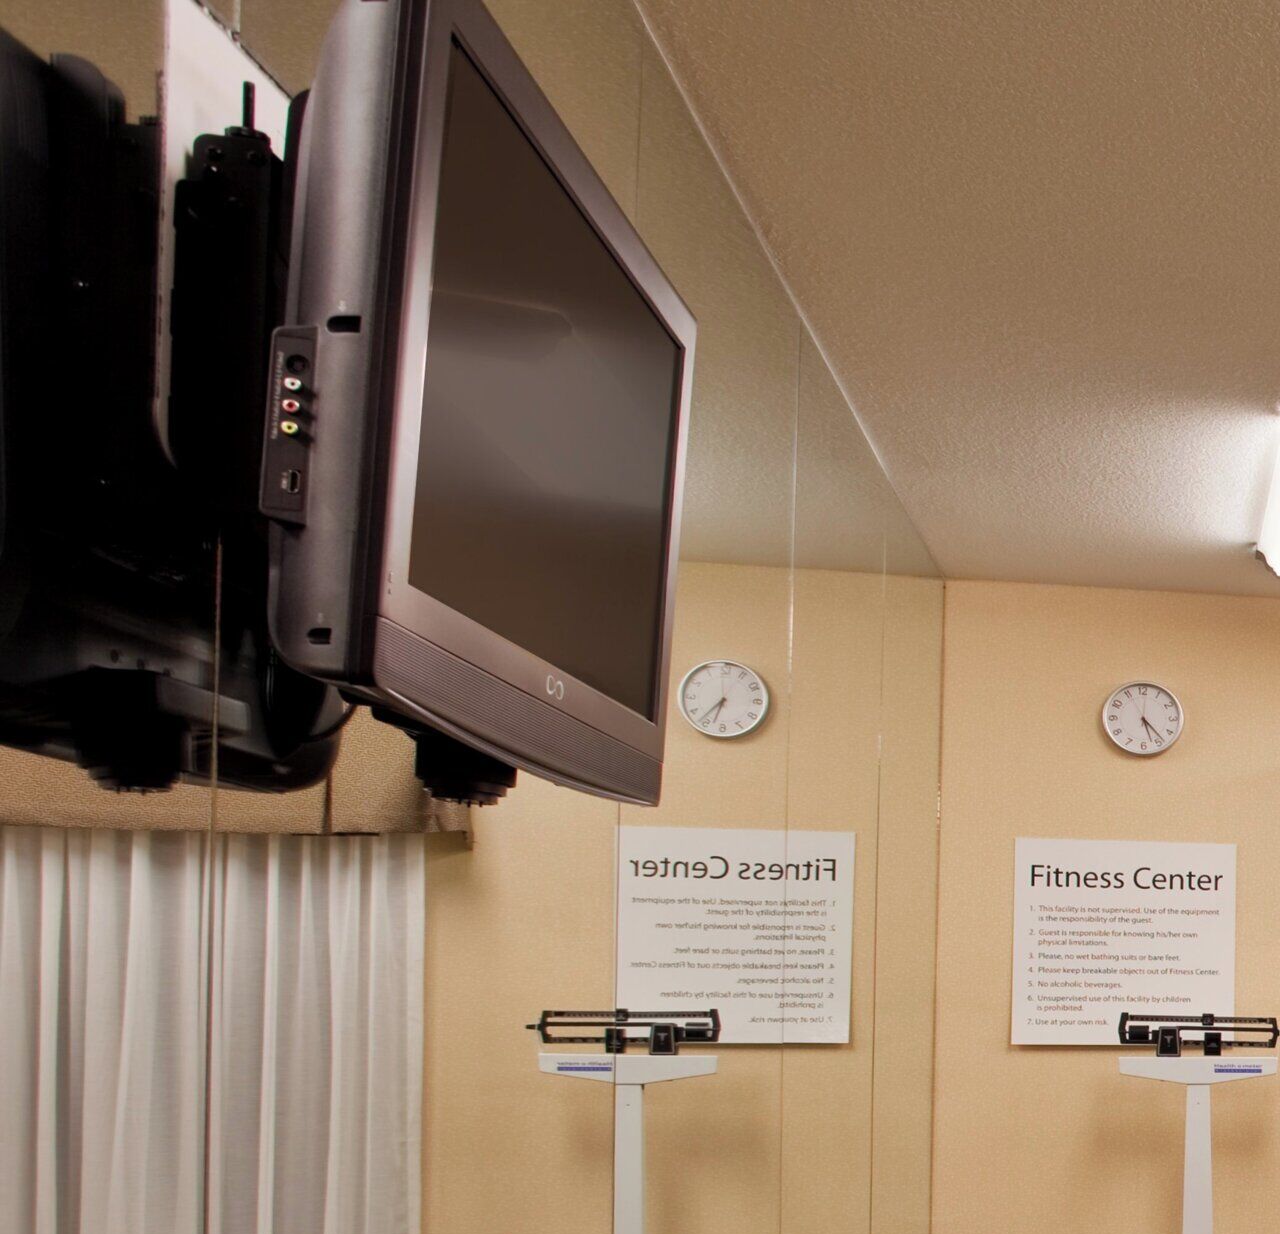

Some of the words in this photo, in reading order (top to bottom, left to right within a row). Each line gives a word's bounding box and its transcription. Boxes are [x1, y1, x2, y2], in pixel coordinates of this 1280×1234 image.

[1124, 690, 1132, 698] 11
[1138, 687, 1147, 696] 12
[1155, 691, 1160, 699] 1
[1112, 699, 1123, 709] 10
[1113, 728, 1122, 736] 8
[1166, 728, 1174, 736] 4
[1125, 737, 1133, 745] 7
[1154, 738, 1163, 747] 5
[1141, 742, 1147, 750] 6
[1031, 865, 1124, 889] Fitness
[1133, 867, 1223, 890] Center
[1055, 906, 1079, 914] facility
[1180, 908, 1219, 916] equipment
[1059, 916, 1108, 924] responsibility
[1068, 930, 1110, 938] responsible
[1123, 931, 1155, 939] knowing
[1037, 939, 1067, 947] physical
[1062, 967, 1081, 975] keep
[1037, 995, 1087, 1003] Unsupervised
[1151, 996, 1161, 1004] by
